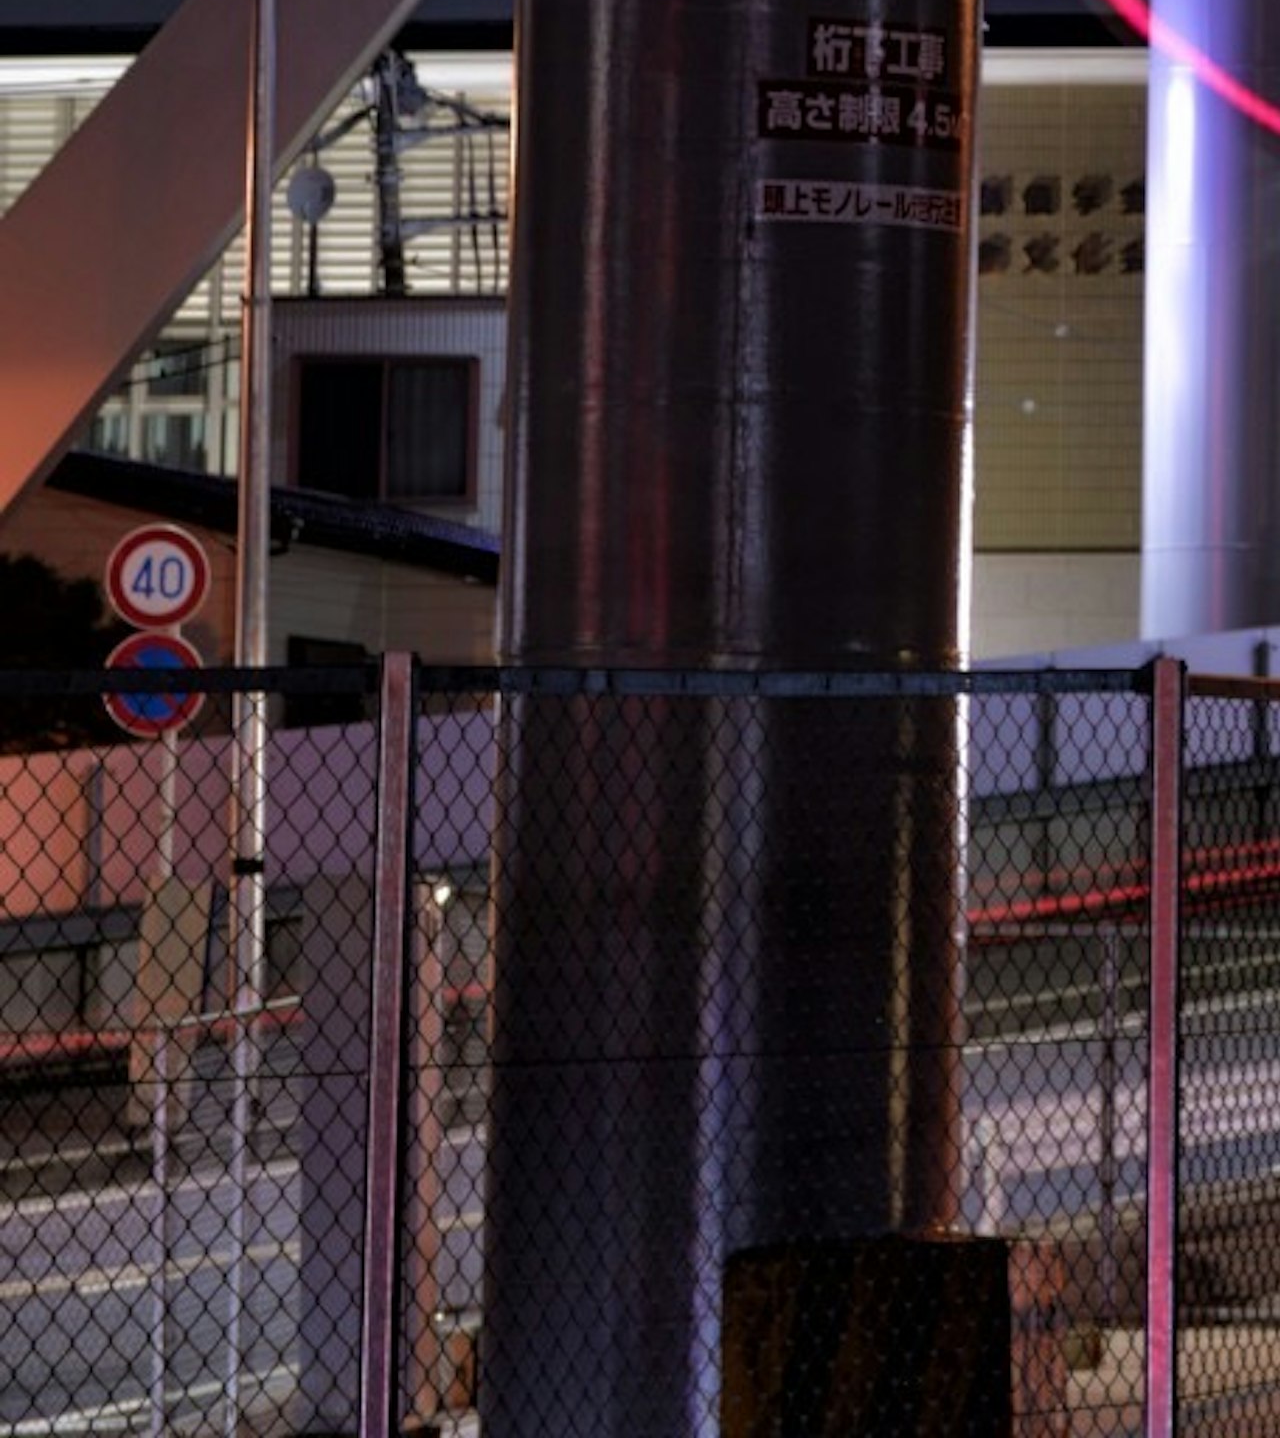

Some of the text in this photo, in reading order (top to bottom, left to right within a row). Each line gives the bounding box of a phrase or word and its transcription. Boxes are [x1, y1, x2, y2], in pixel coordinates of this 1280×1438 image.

[813, 24, 945, 79] 桁下工事
[766, 89, 901, 135] 高さ制限
[132, 556, 185, 599] 40
